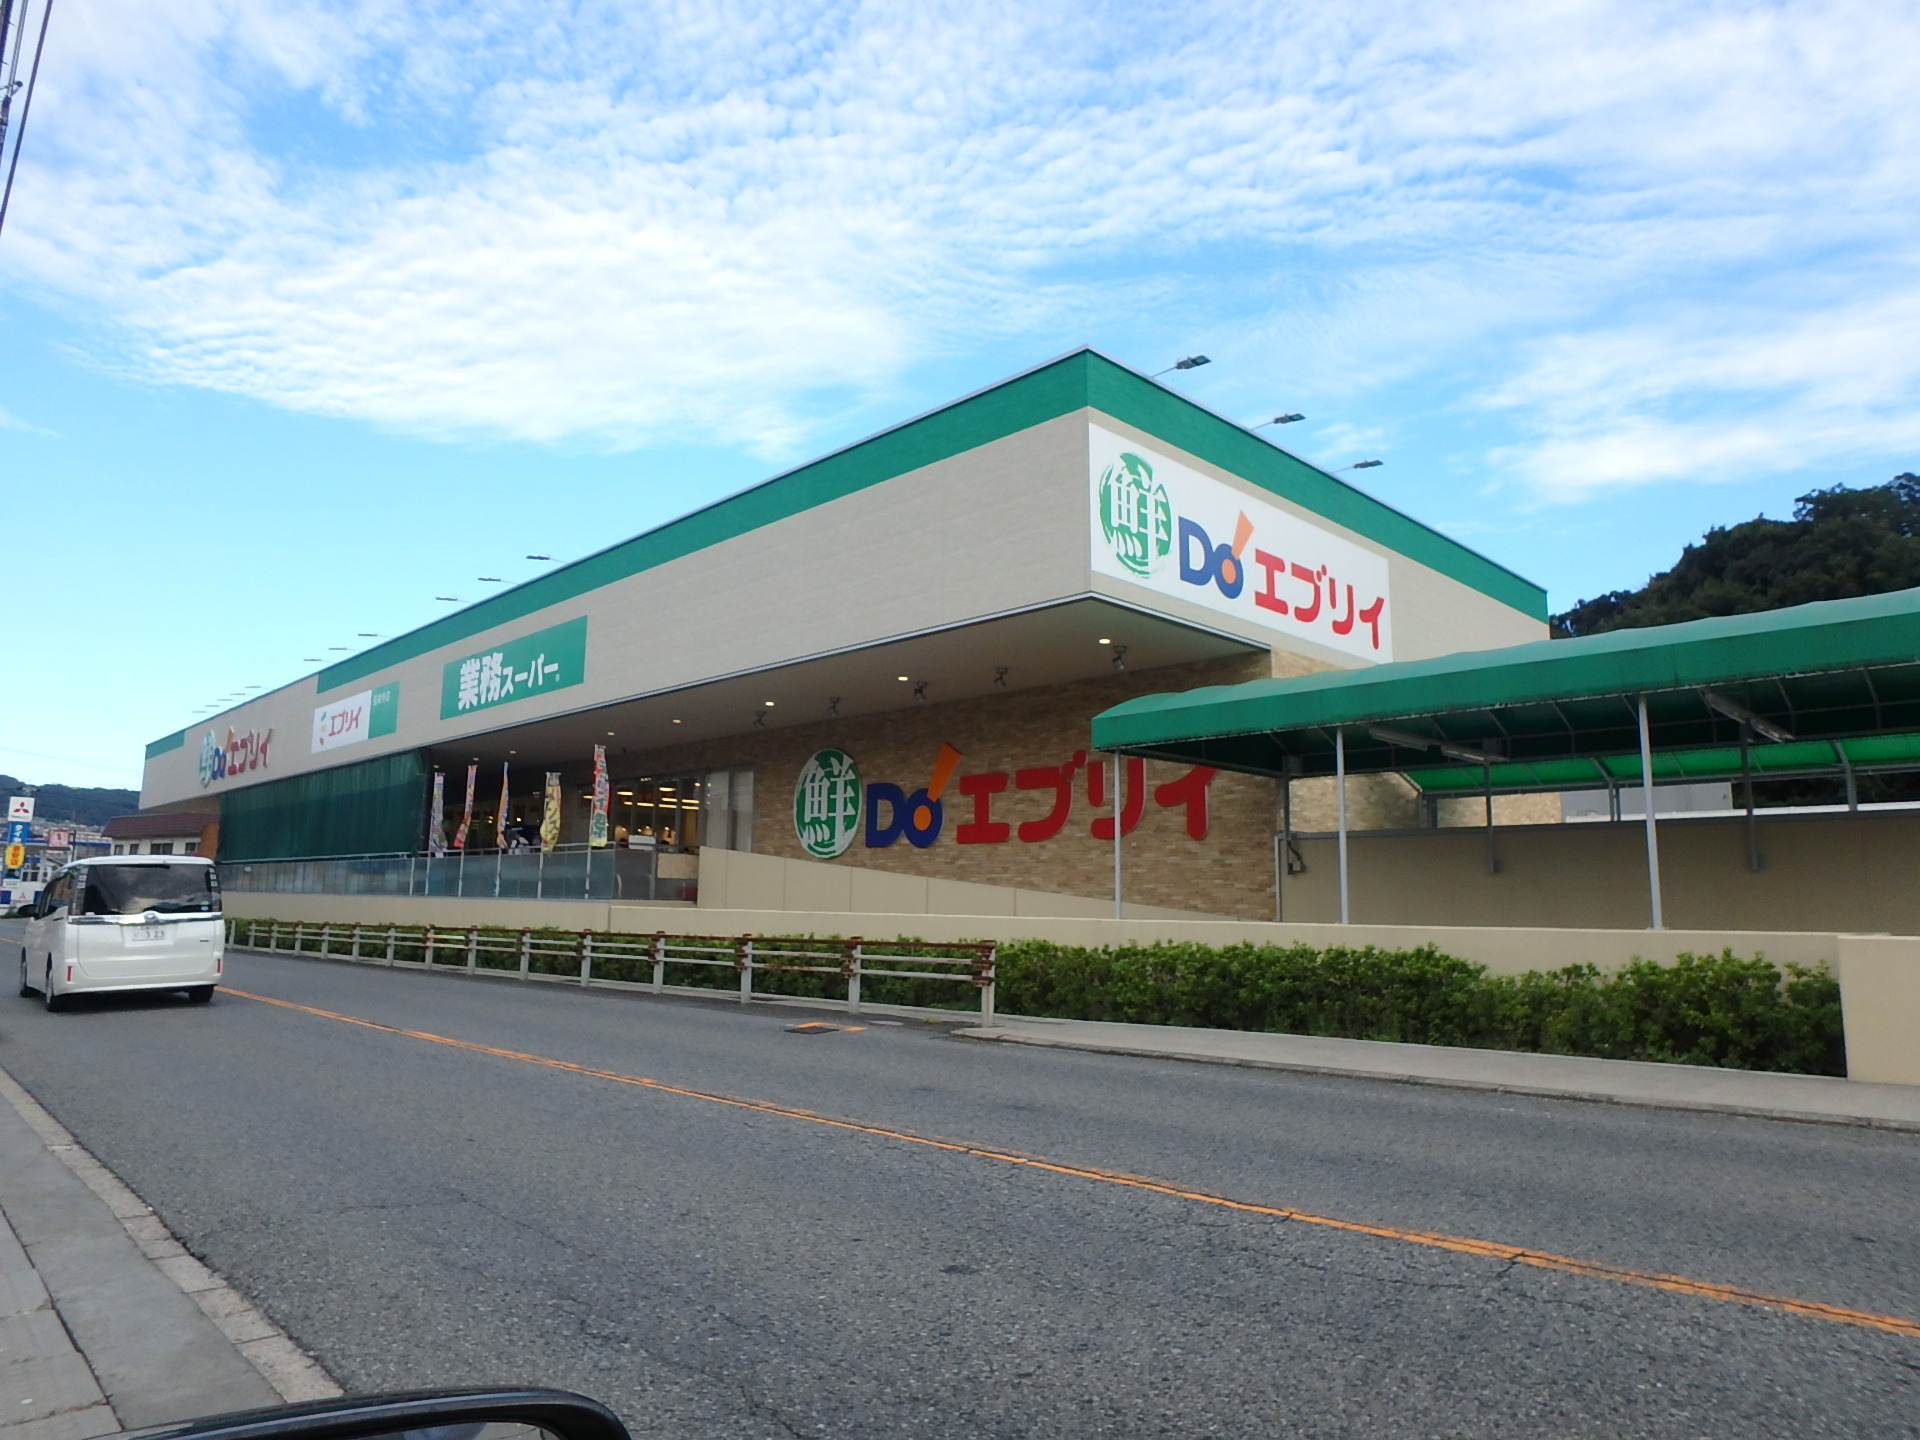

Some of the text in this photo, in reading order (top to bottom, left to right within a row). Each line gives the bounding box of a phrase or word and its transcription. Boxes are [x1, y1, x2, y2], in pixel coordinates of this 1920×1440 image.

[458, 652, 559, 710] 業務スーパー
